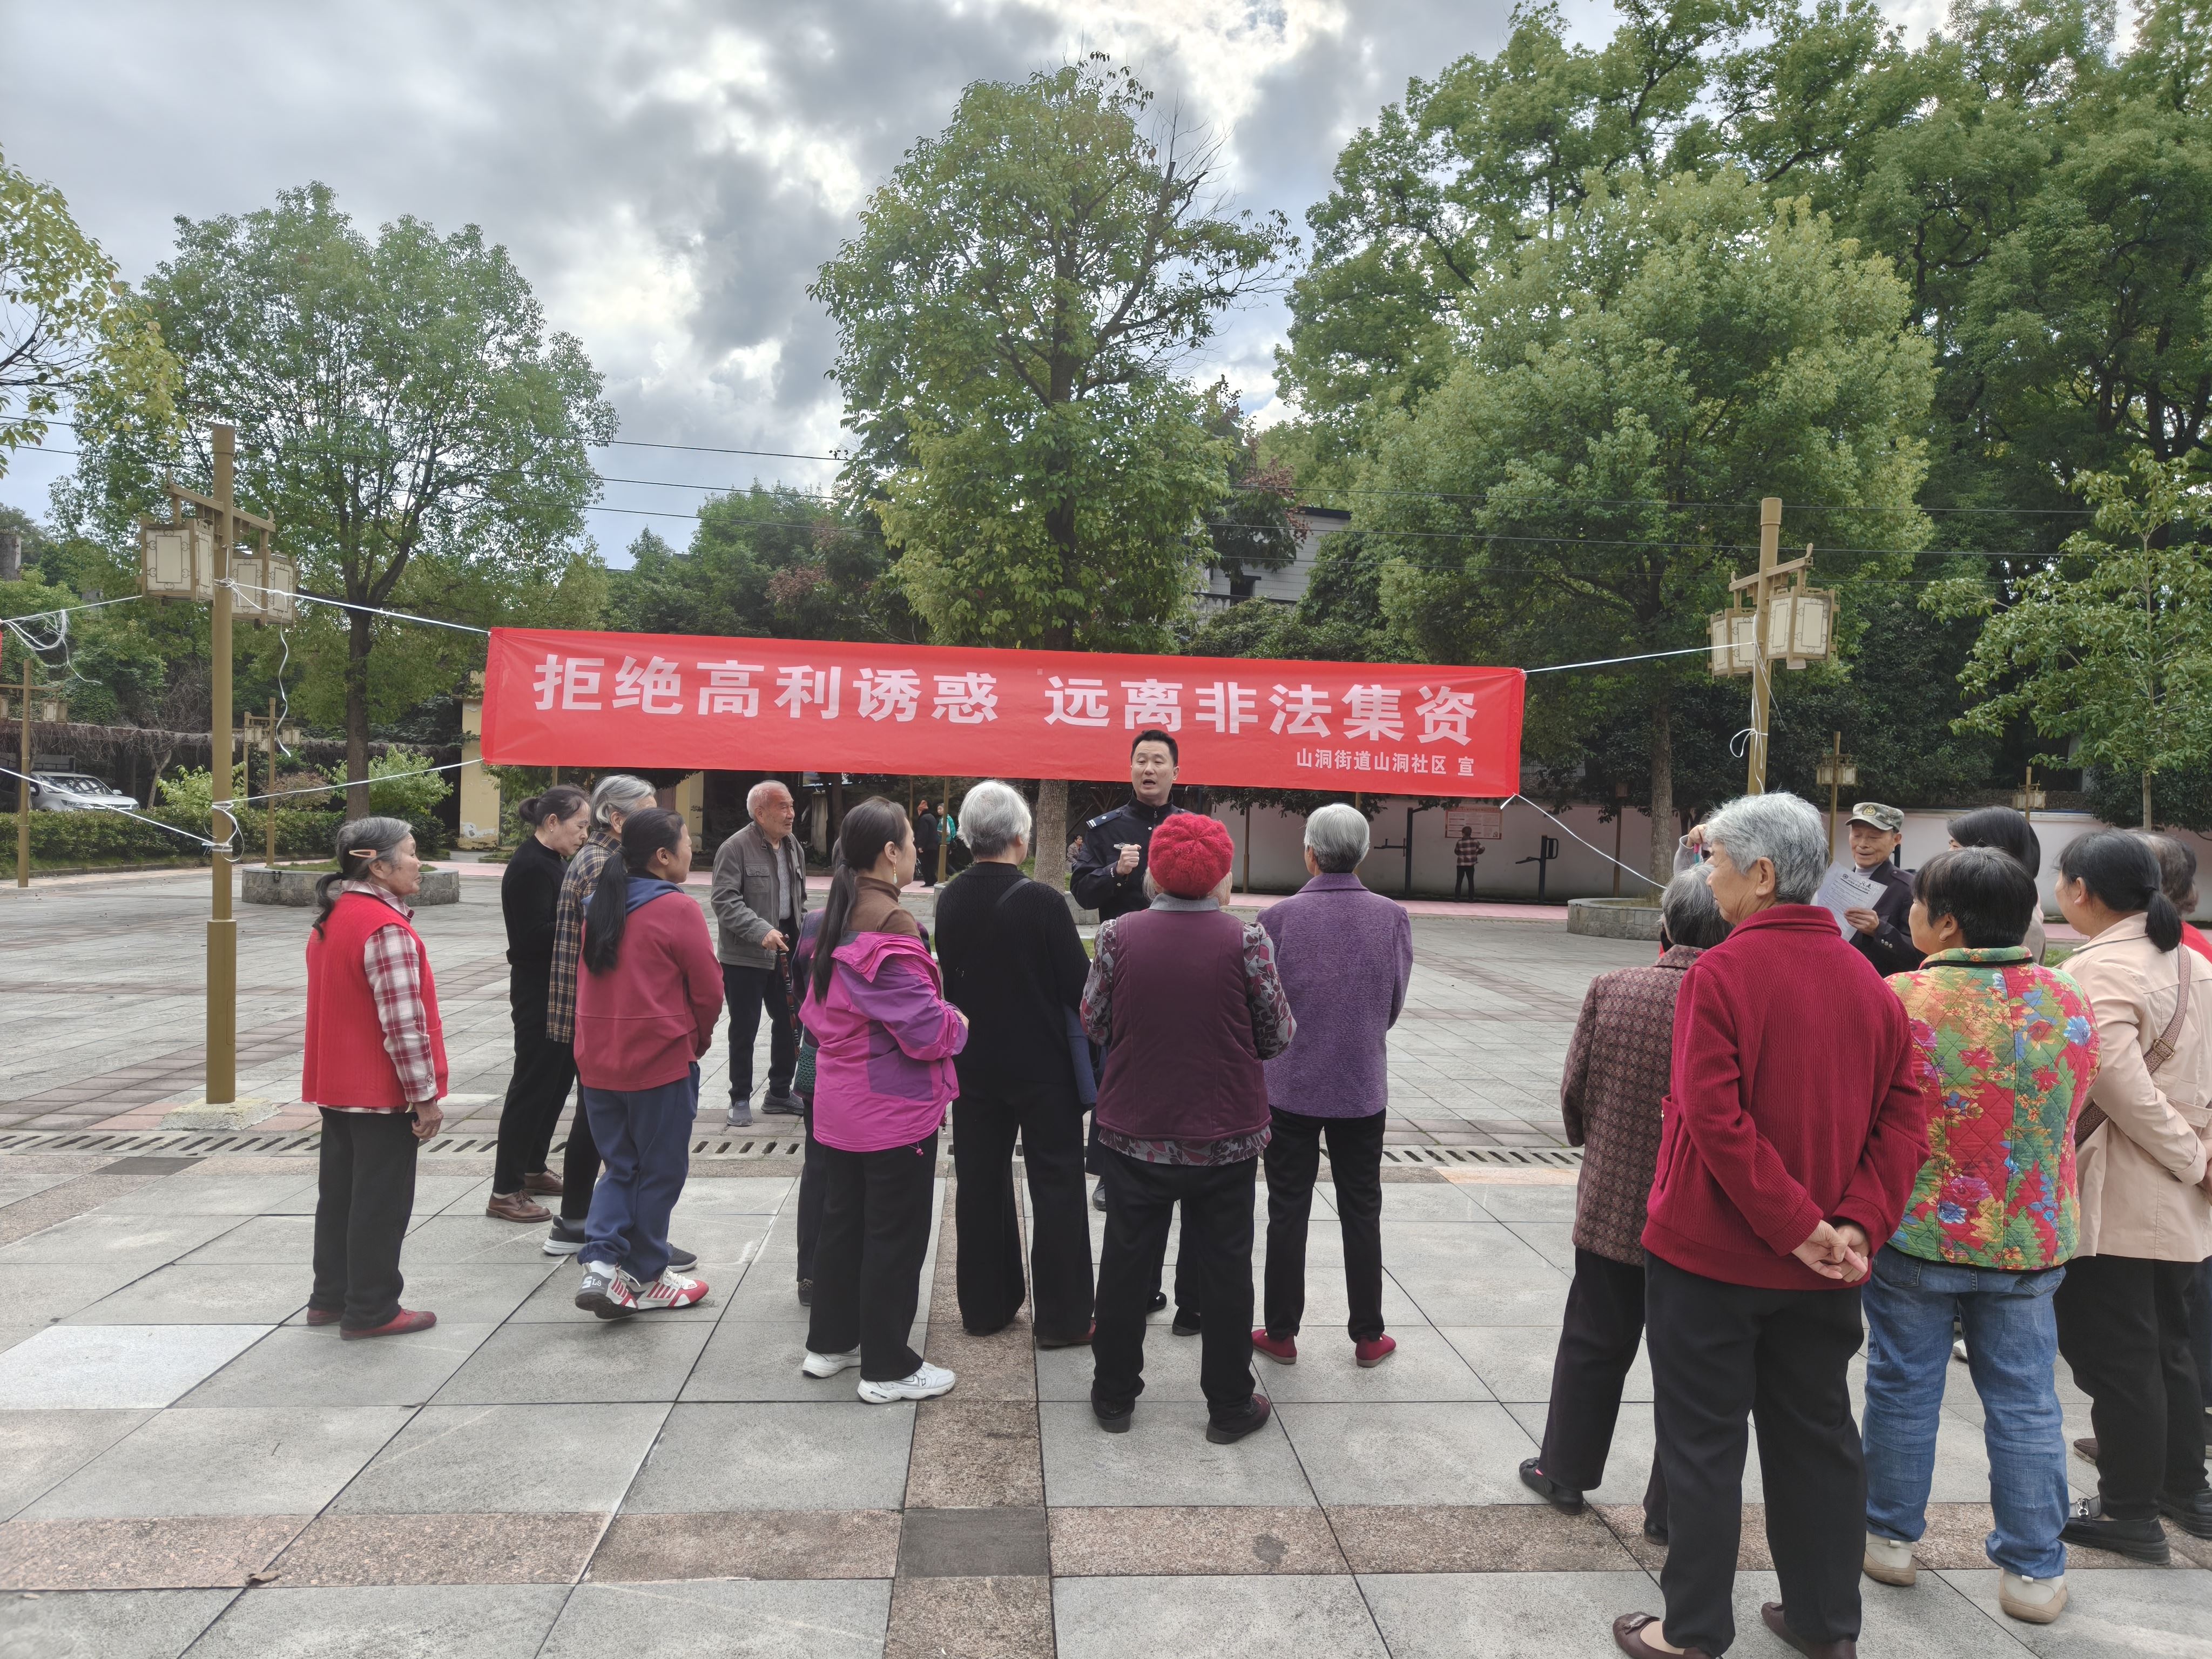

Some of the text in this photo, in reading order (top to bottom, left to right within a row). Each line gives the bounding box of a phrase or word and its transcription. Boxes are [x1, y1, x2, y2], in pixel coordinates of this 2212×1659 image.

[532, 653, 1478, 745] 拒绝高利诱惑 远离非法集资
[1297, 748, 1474, 777] 山洞街道山洞社区 宣
